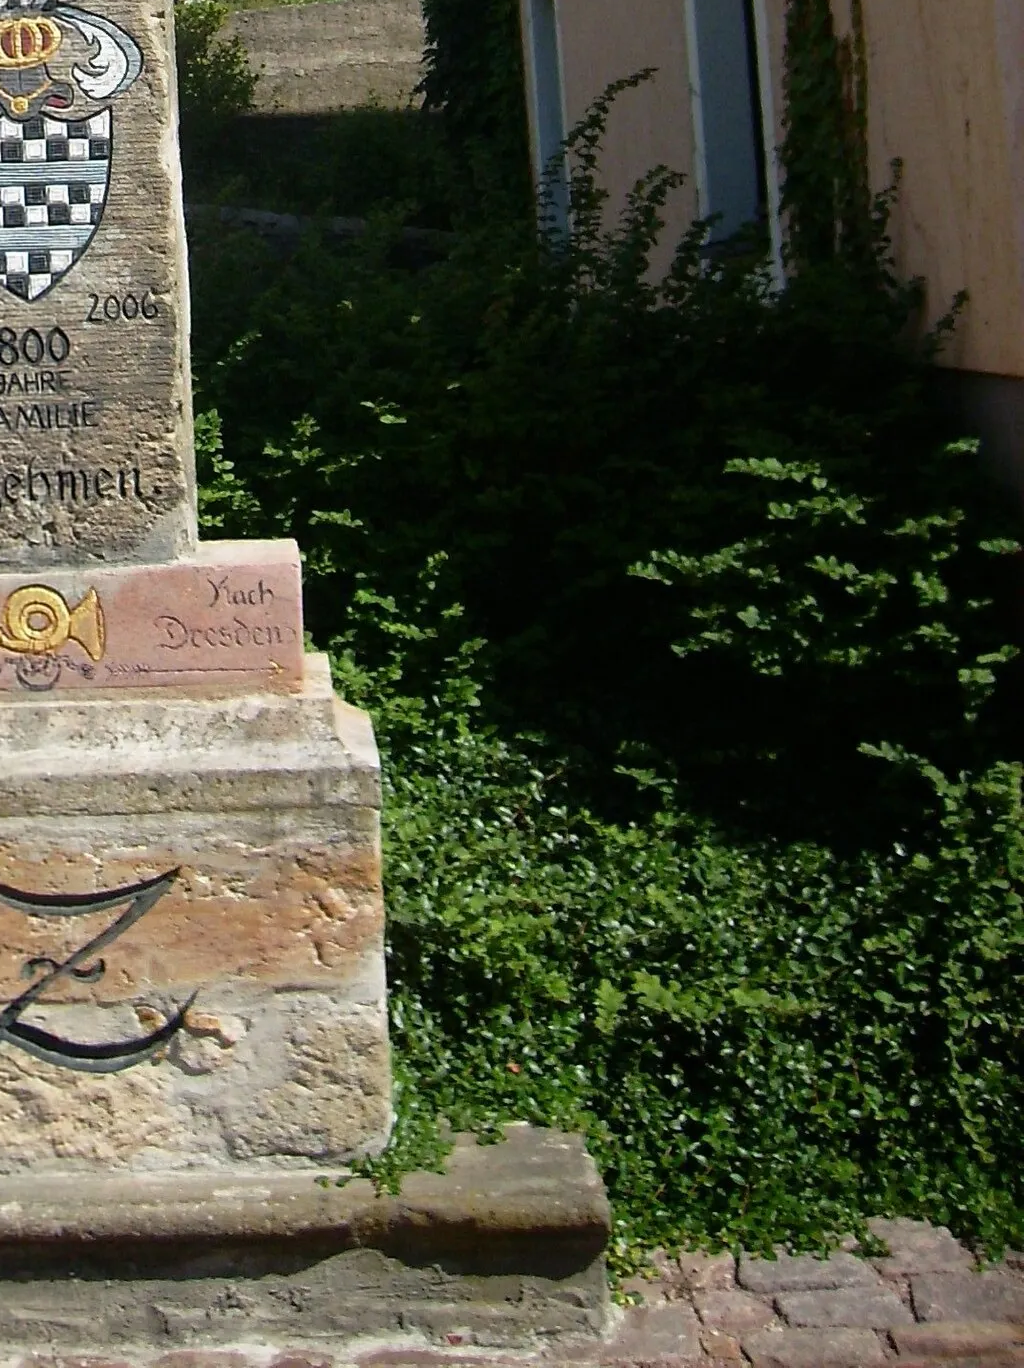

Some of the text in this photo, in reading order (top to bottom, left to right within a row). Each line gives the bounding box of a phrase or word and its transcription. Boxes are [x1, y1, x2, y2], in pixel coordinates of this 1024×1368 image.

[85, 293, 160, 323] 2006
[206, 575, 275, 608] Nach
[152, 615, 284, 650] Dresden
